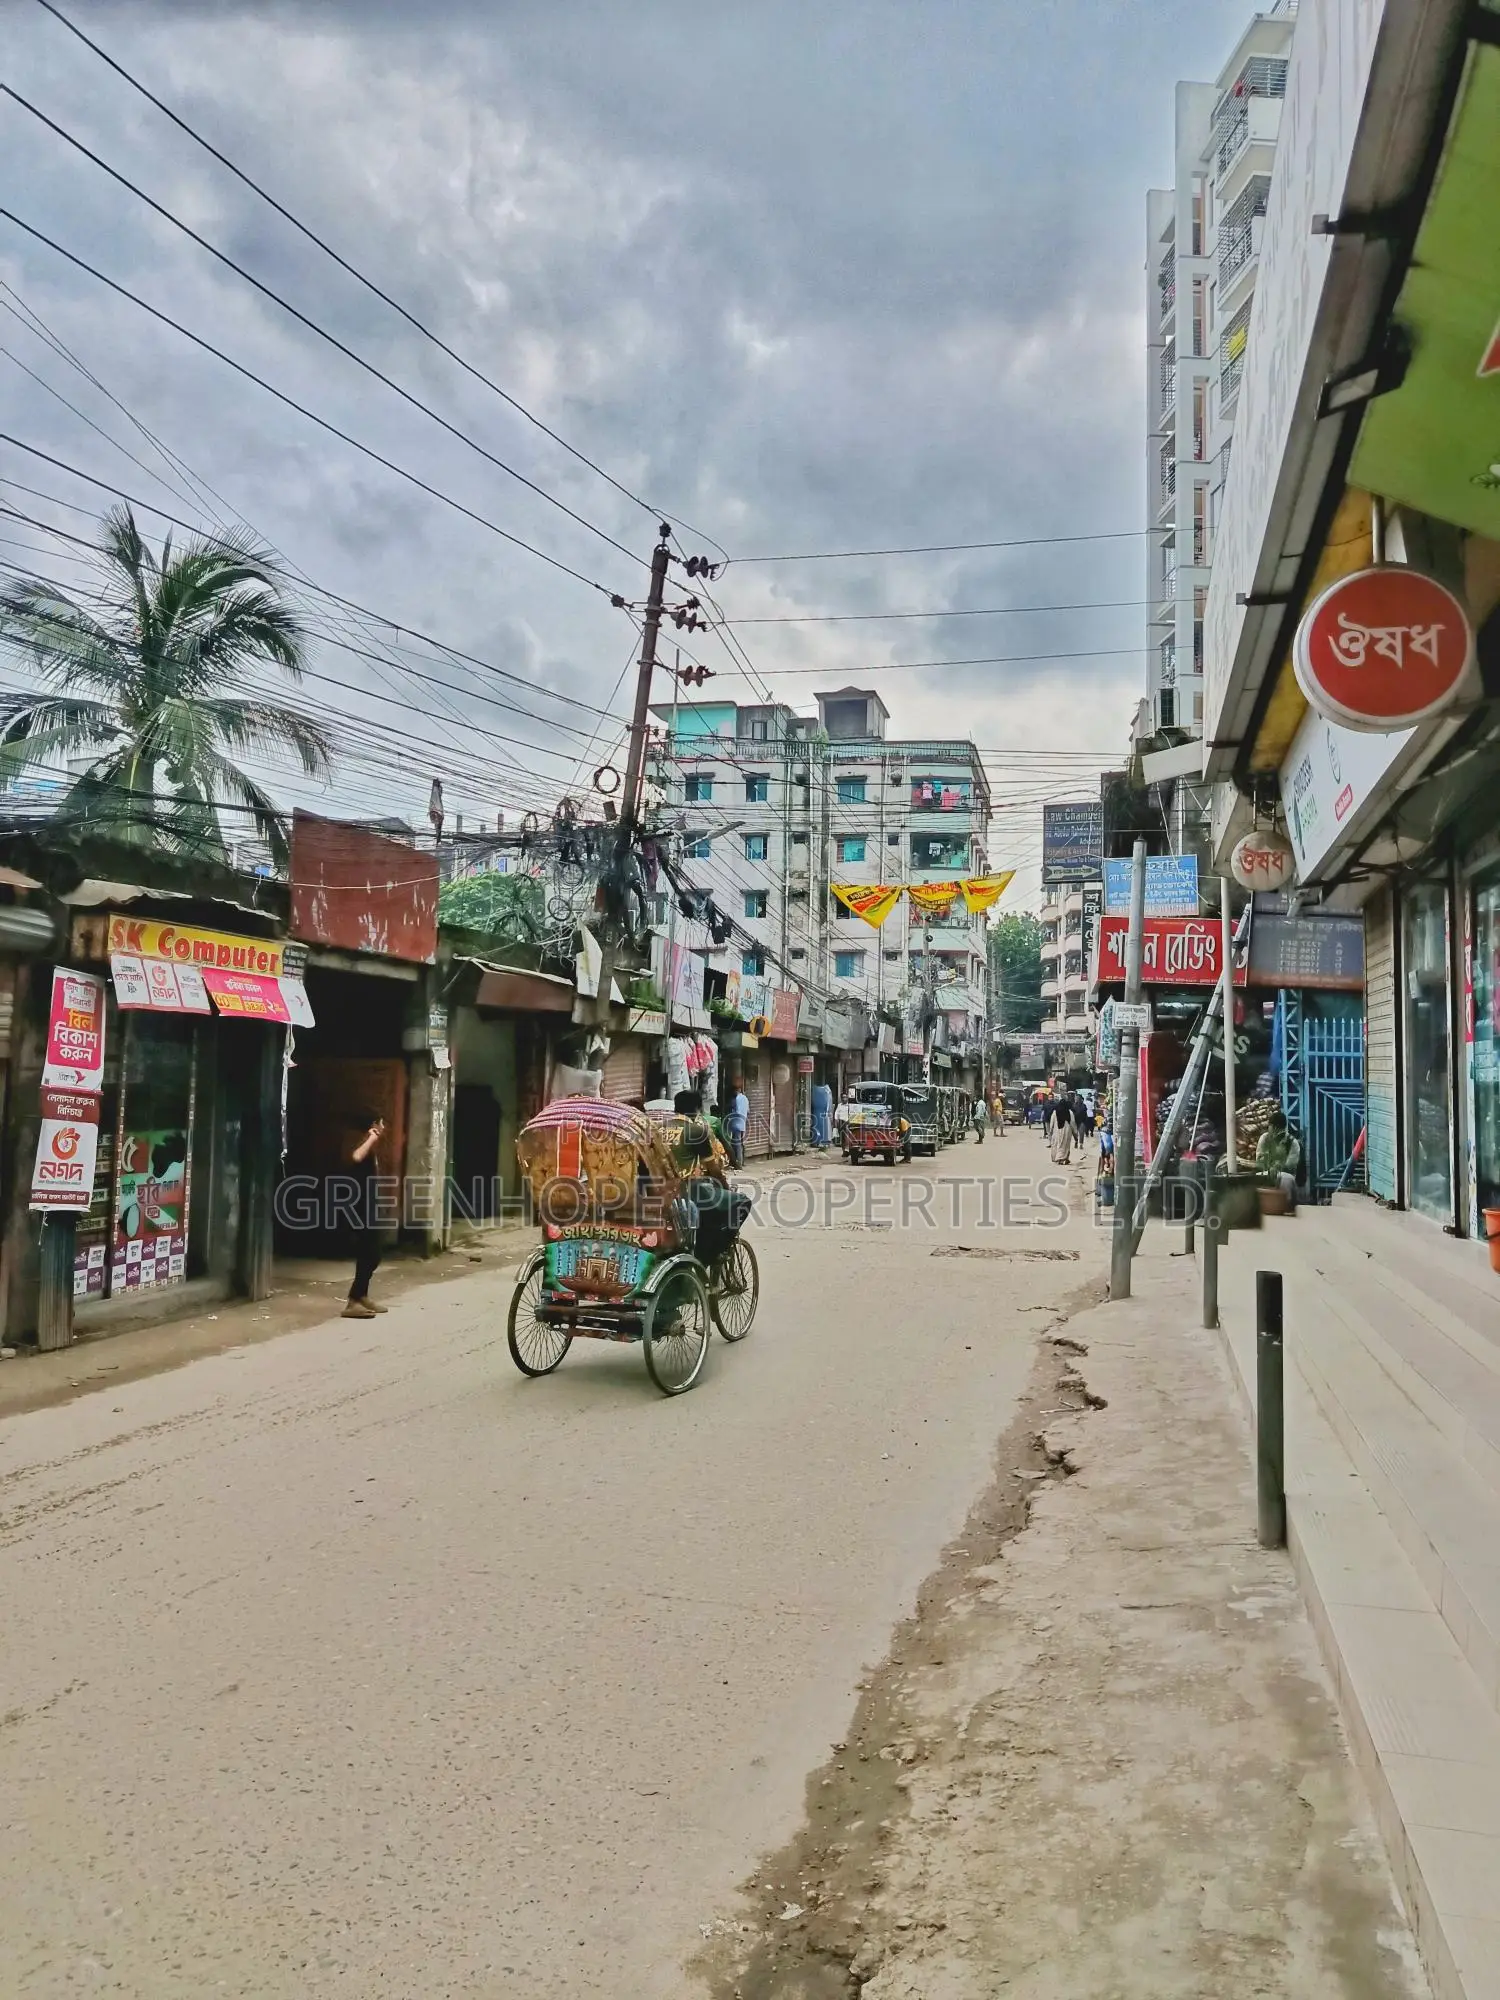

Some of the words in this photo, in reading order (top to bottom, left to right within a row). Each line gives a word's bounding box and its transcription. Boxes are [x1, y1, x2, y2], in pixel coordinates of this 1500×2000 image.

[1328, 612, 1446, 670] ঔষধ
[1238, 844, 1285, 876] ঔষধ
[112, 918, 148, 952] SK
[157, 926, 281, 973] Computer
[1164, 922, 1216, 974] বেডিং
[68, 1008, 94, 1031] বিল
[53, 1021, 98, 1049] বিকাশ
[60, 1044, 93, 1063] করুন
[39, 1161, 84, 1182] নগদ
